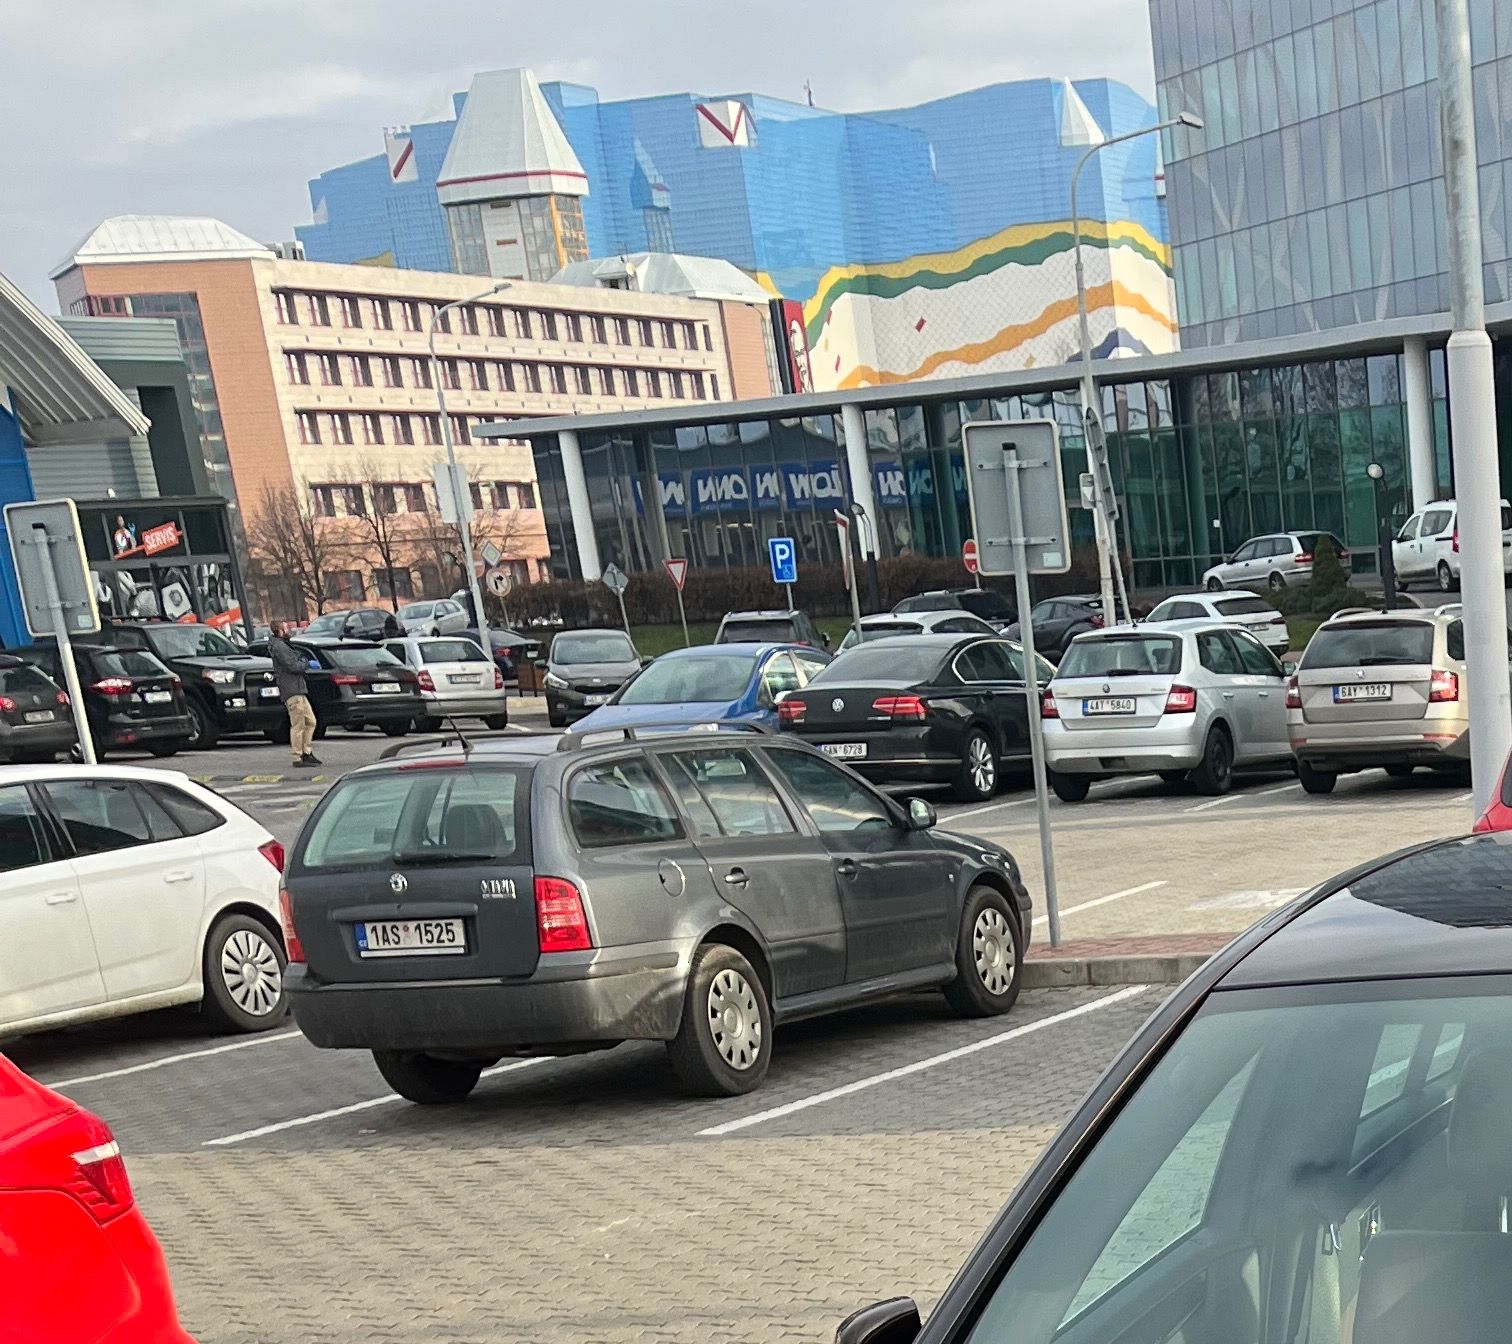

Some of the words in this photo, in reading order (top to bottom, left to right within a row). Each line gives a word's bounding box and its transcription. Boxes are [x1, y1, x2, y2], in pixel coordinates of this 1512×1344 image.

[144, 526, 175, 548] SERVIS
[775, 543, 790, 569] P
[1365, 685, 1387, 696] 1312
[370, 924, 401, 946] 1AS
[414, 922, 456, 945] 1525
